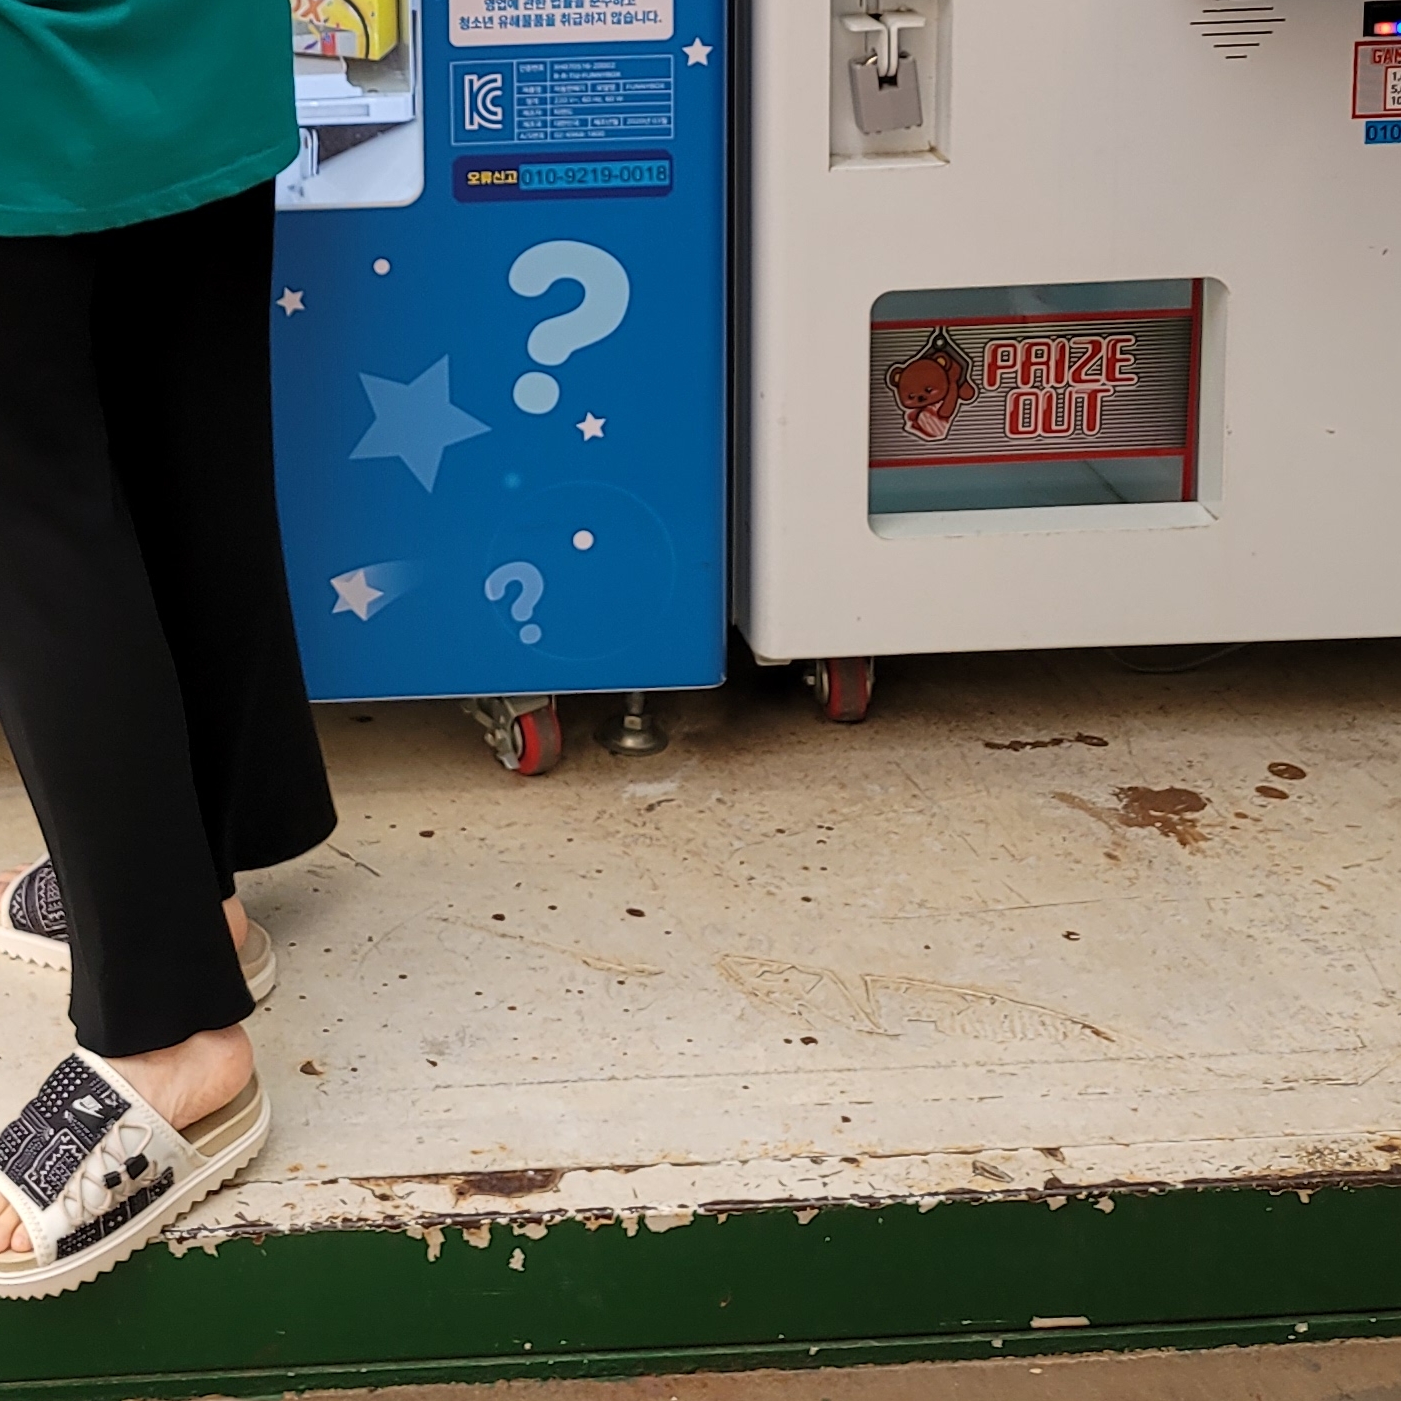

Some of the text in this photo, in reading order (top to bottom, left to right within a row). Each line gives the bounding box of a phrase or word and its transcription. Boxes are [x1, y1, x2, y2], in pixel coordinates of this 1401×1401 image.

[459, 16, 494, 30] 청소년
[560, 12, 607, 27] 취급하지
[610, 10, 663, 25] 않습니다.
[467, 164, 667, 186] 오류신고 010-9219-0018
[1006, 386, 1115, 439] OUT
